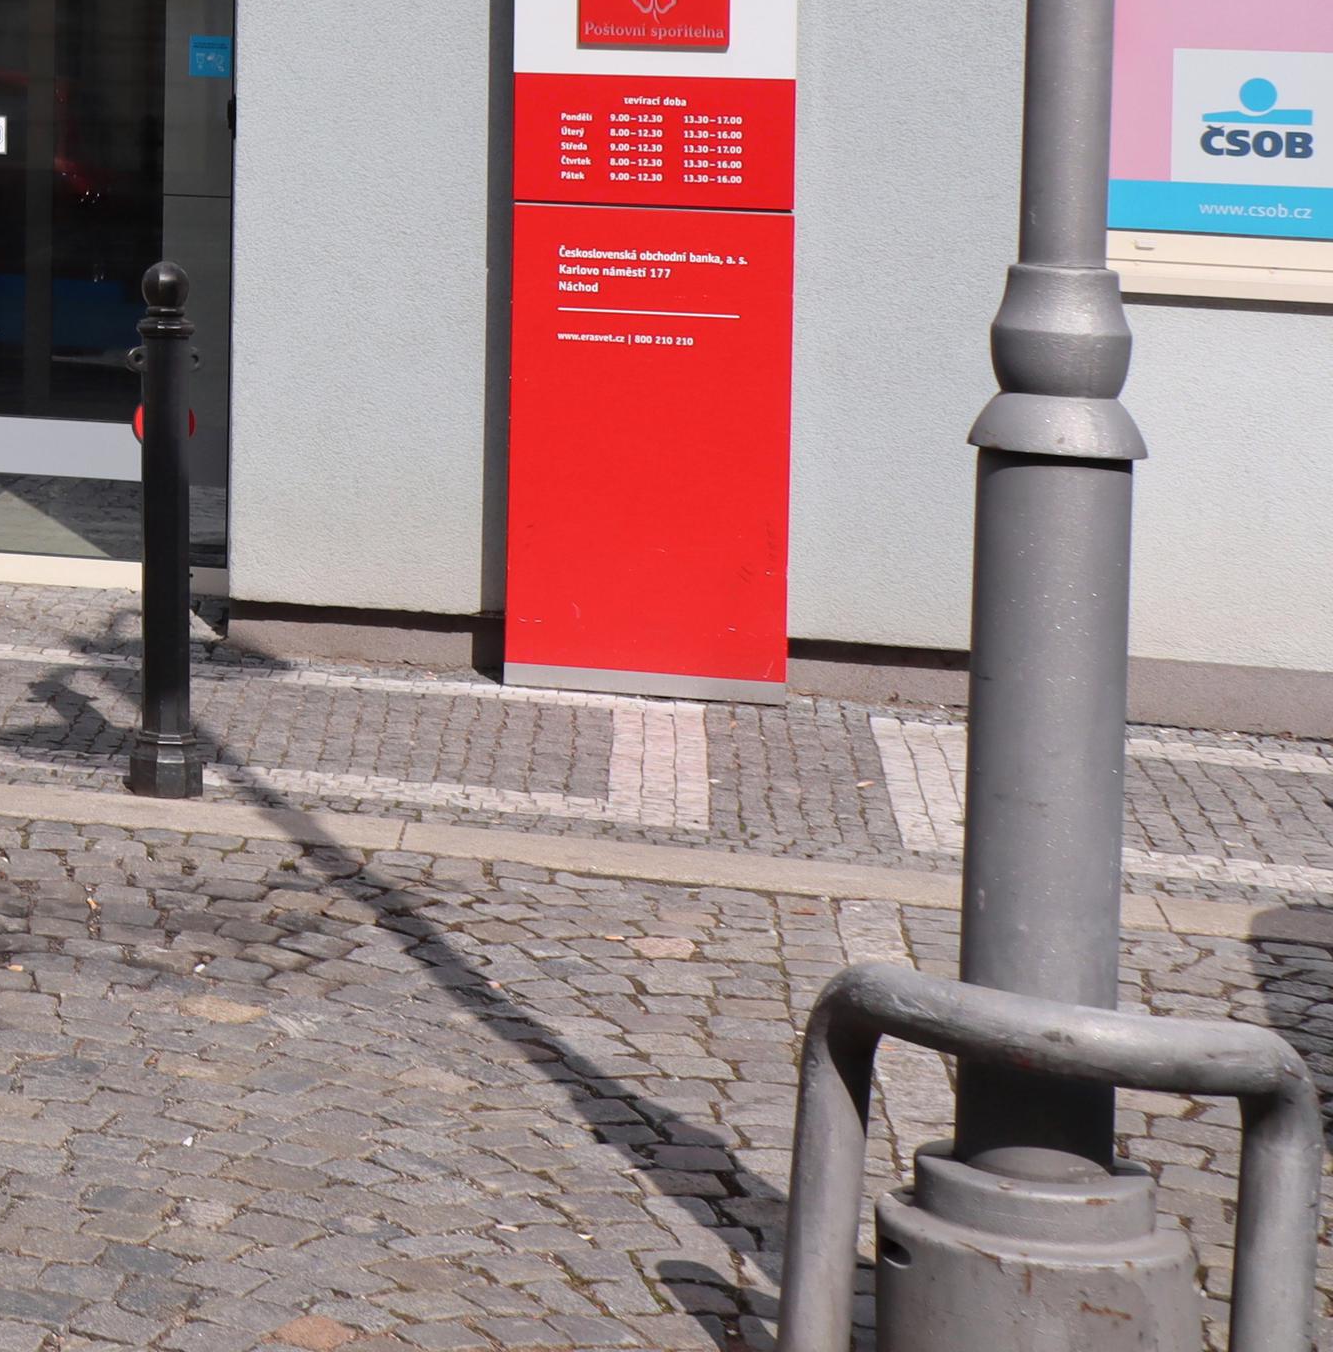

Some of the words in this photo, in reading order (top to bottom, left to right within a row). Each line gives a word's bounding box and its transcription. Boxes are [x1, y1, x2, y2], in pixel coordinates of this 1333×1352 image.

[584, 21, 646, 37] Poštovní
[650, 22, 725, 40] spořitelna
[663, 97, 687, 107] doba
[560, 112, 593, 122] Pondělí
[560, 127, 585, 137] Úterý
[560, 141, 588, 151] Středa
[1200, 125, 1313, 159] ČSOB
[560, 155, 592, 166] Čtvrtek
[560, 170, 586, 180] Pátek
[1199, 203, 1312, 219] www.csob.cz
[558, 245, 637, 260] Československá
[639, 251, 687, 262] obchodní
[689, 253, 724, 265] banka,
[726, 256, 736, 265] a.
[738, 257, 748, 265] s.
[558, 264, 600, 275] Karlovo
[602, 266, 646, 278] náměstí
[650, 268, 671, 279] 177
[558, 281, 599, 293] Náchod
[557, 332, 625, 343] www.erasvet.cz
[634, 334, 652, 344] 800
[655, 336, 673, 345] 210
[675, 336, 694, 346] 210
